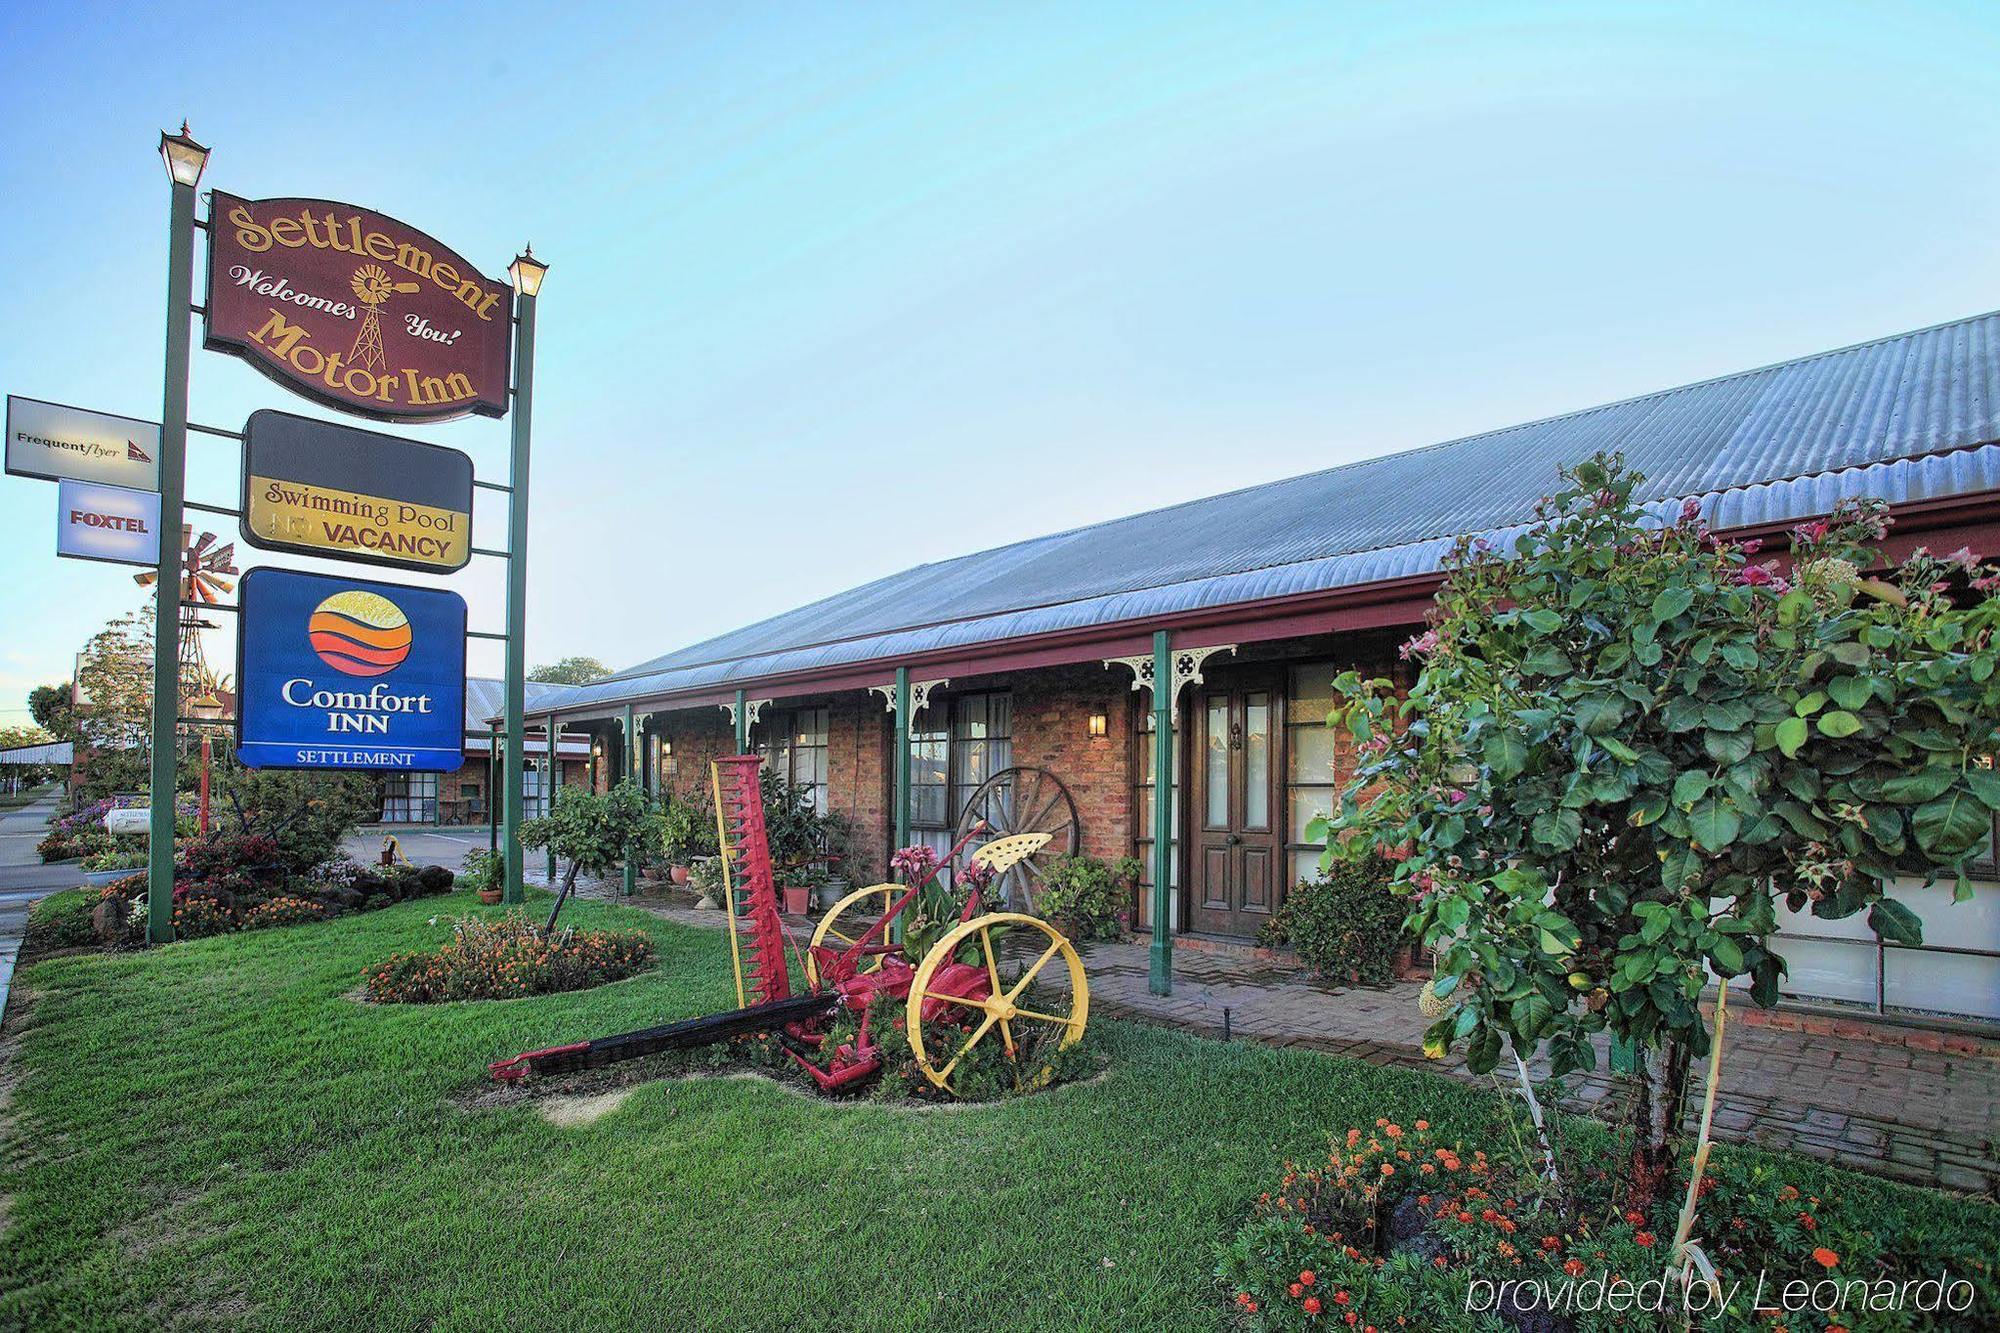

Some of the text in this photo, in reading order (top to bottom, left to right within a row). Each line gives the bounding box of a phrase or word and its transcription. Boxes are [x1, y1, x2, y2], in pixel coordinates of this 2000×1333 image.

[228, 206, 500, 321] Settlement
[229, 265, 462, 345] Welcomes You!
[248, 307, 478, 405] Motor Inn
[70, 510, 149, 534] FOXTEL
[265, 482, 455, 532] Swimming Pool
[322, 521, 451, 558] VACANCY
[281, 678, 432, 714] Comfort
[327, 712, 389, 734] INN
[297, 750, 415, 766] SETTLEMENT
